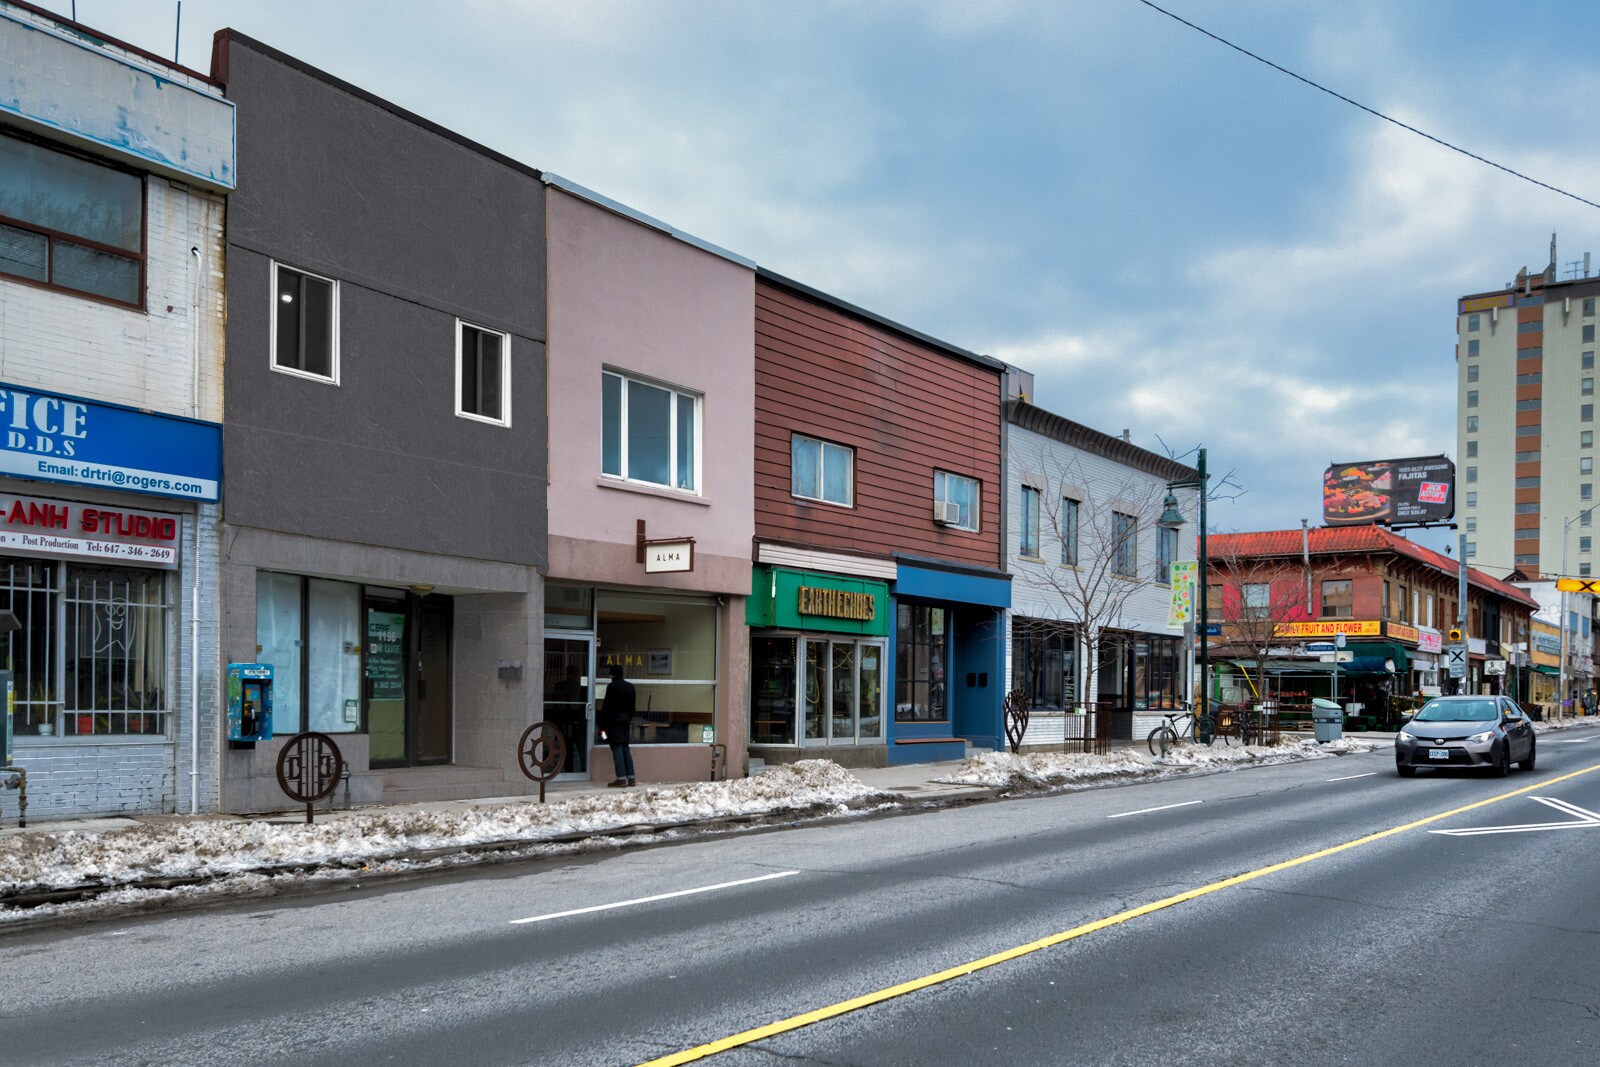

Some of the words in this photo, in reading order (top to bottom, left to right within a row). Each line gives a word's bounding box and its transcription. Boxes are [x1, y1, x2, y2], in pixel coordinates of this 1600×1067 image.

[38, 461, 78, 476] Email:
[81, 466, 202, 494] drtri@rogers.com
[1398, 472, 1427, 480] FAJITAS
[81, 509, 176, 541] STUDIO
[22, 534, 38, 546] Post
[40, 537, 79, 550] Production
[86, 541, 102, 553] Tel:
[104, 544, 120, 554] 647
[127, 546, 143, 556] 346
[150, 547, 170, 559] 2649
[656, 552, 680, 562] ALMA
[1301, 623, 1320, 634] FRUIT
[1321, 623, 1335, 633] AND
[1335, 622, 1363, 633] FLOWER
[378, 631, 397, 643] 1196
[606, 654, 643, 666] ALMA
